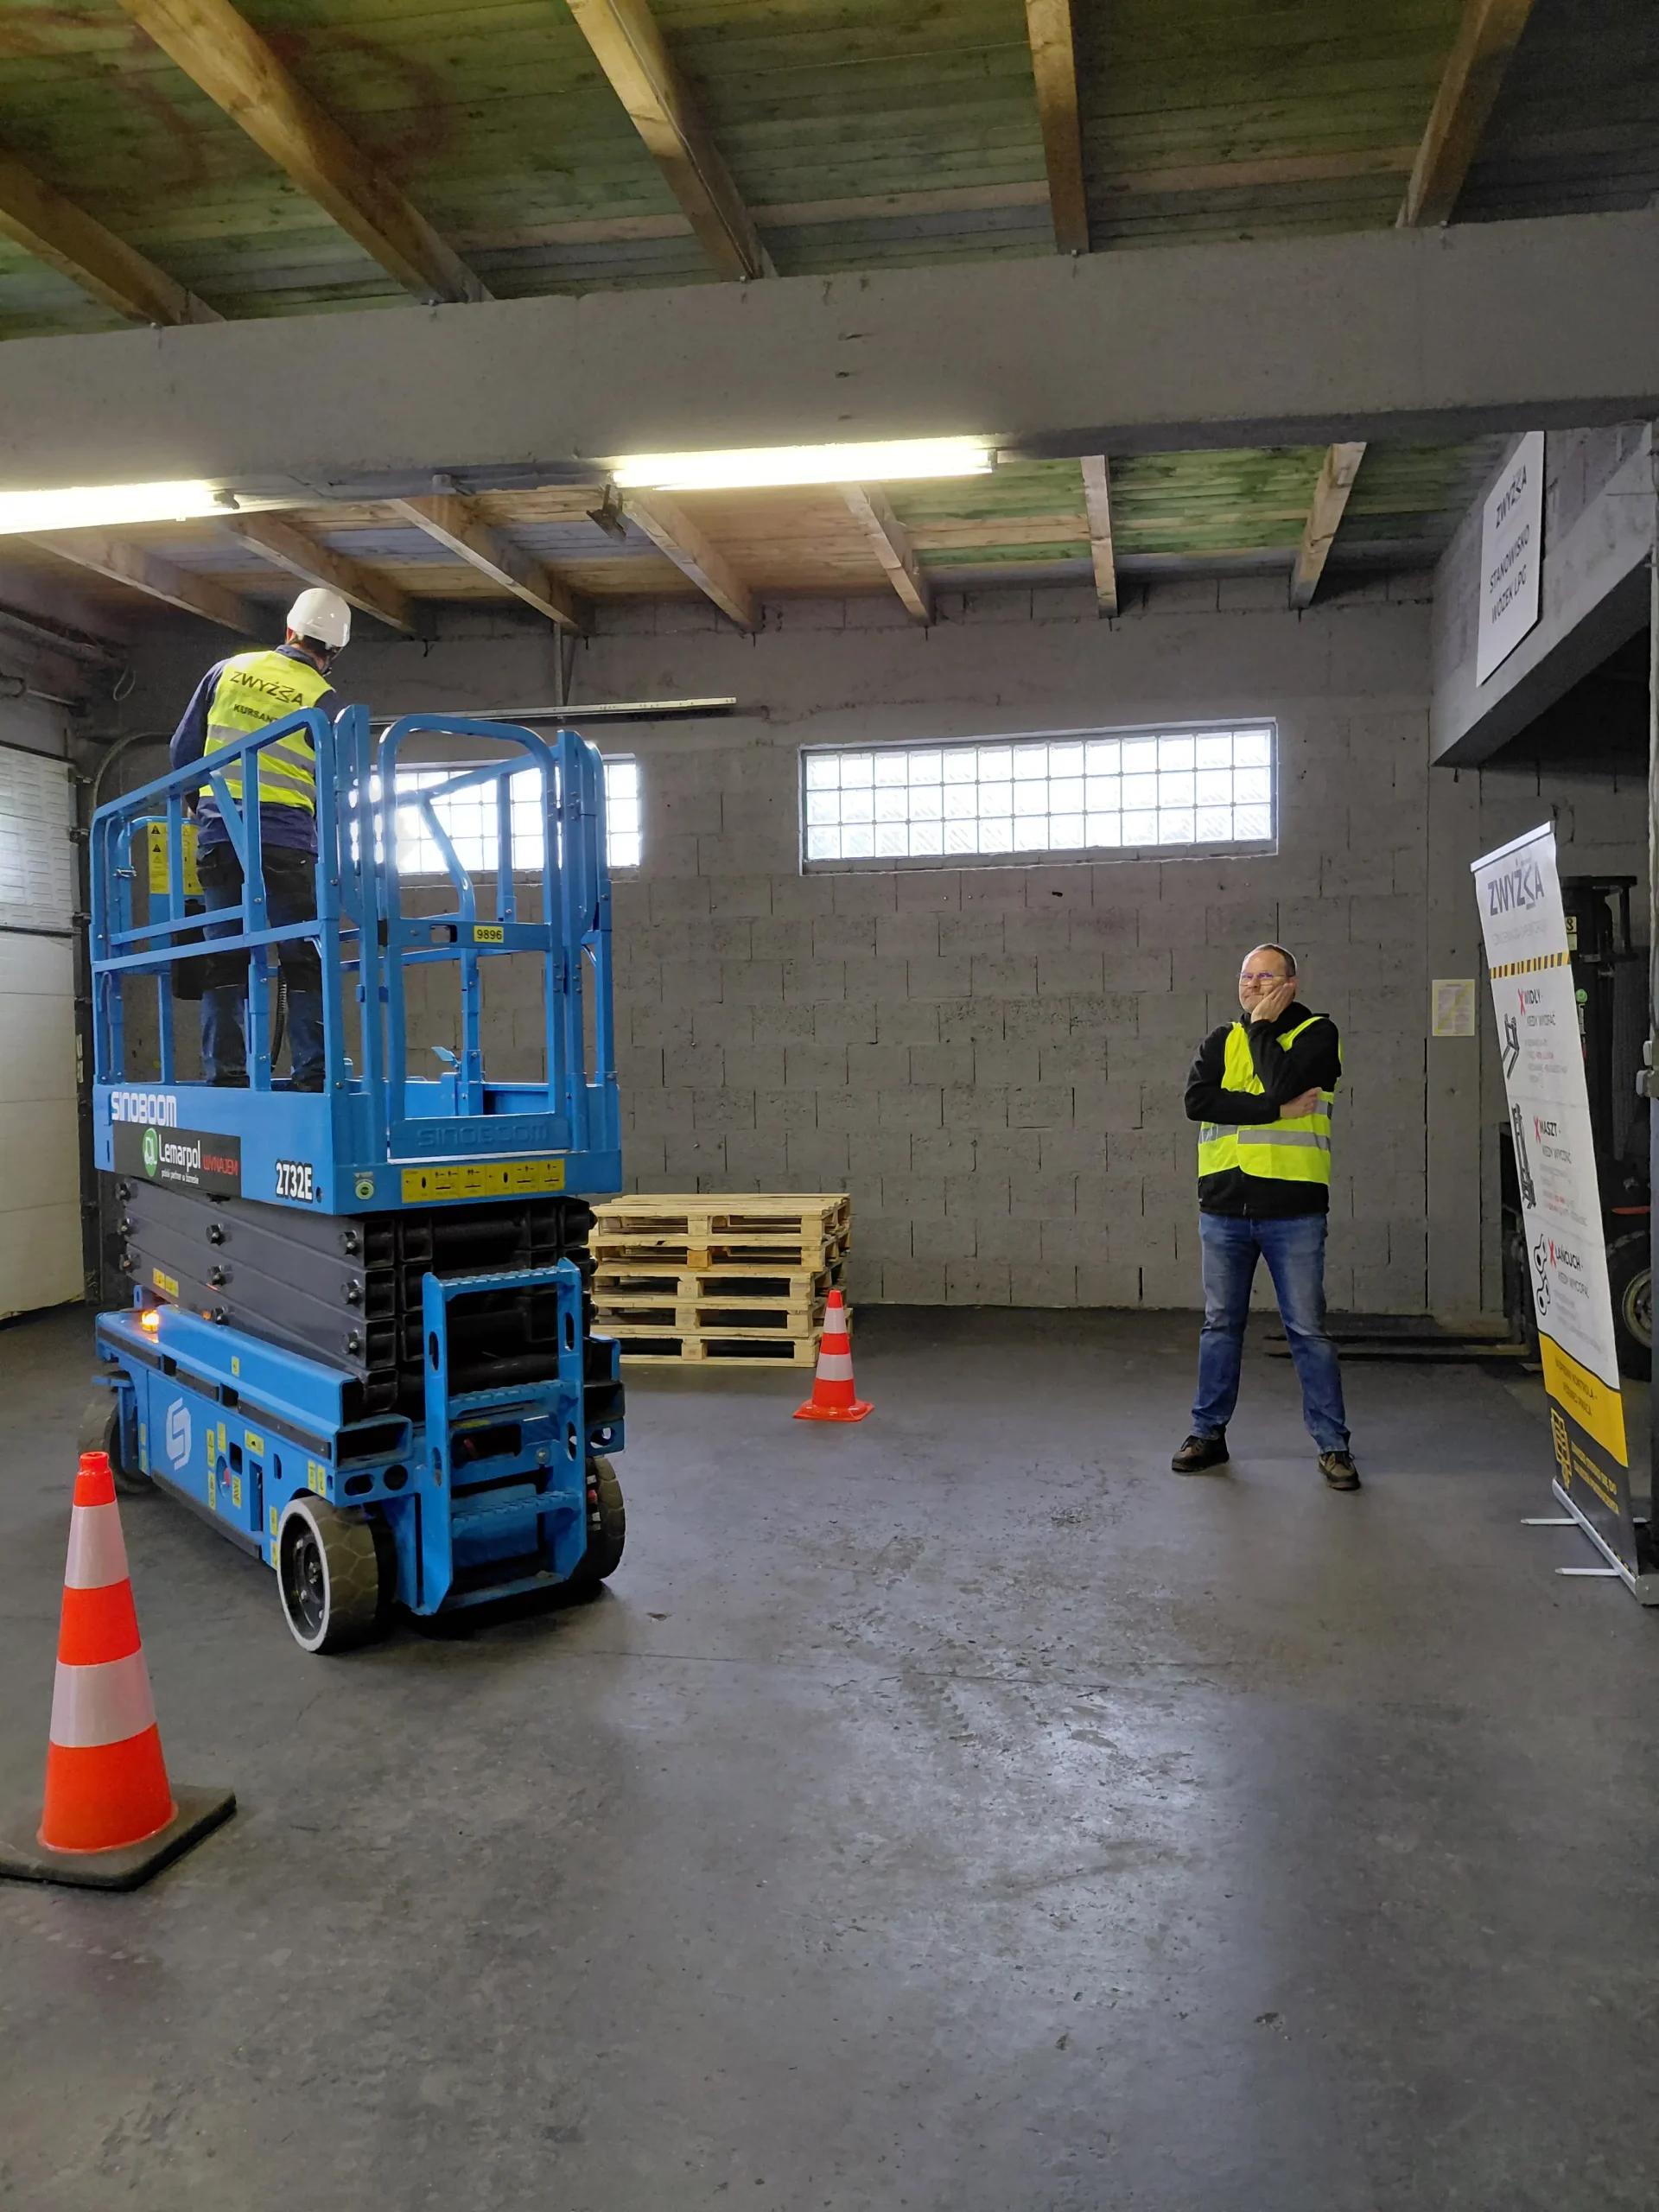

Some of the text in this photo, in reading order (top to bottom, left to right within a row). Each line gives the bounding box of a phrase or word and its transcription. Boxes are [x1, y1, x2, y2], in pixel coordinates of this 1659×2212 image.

[1490, 524, 1530, 594] STANOWISKO
[1514, 564, 1527, 595] LPG
[477, 929, 502, 940] 9896
[111, 1091, 177, 1128] SINOBOOM
[1539, 1122, 1559, 1137] MASZT
[159, 1134, 201, 1173] Lemarpol
[276, 1160, 313, 1200] 2732E
